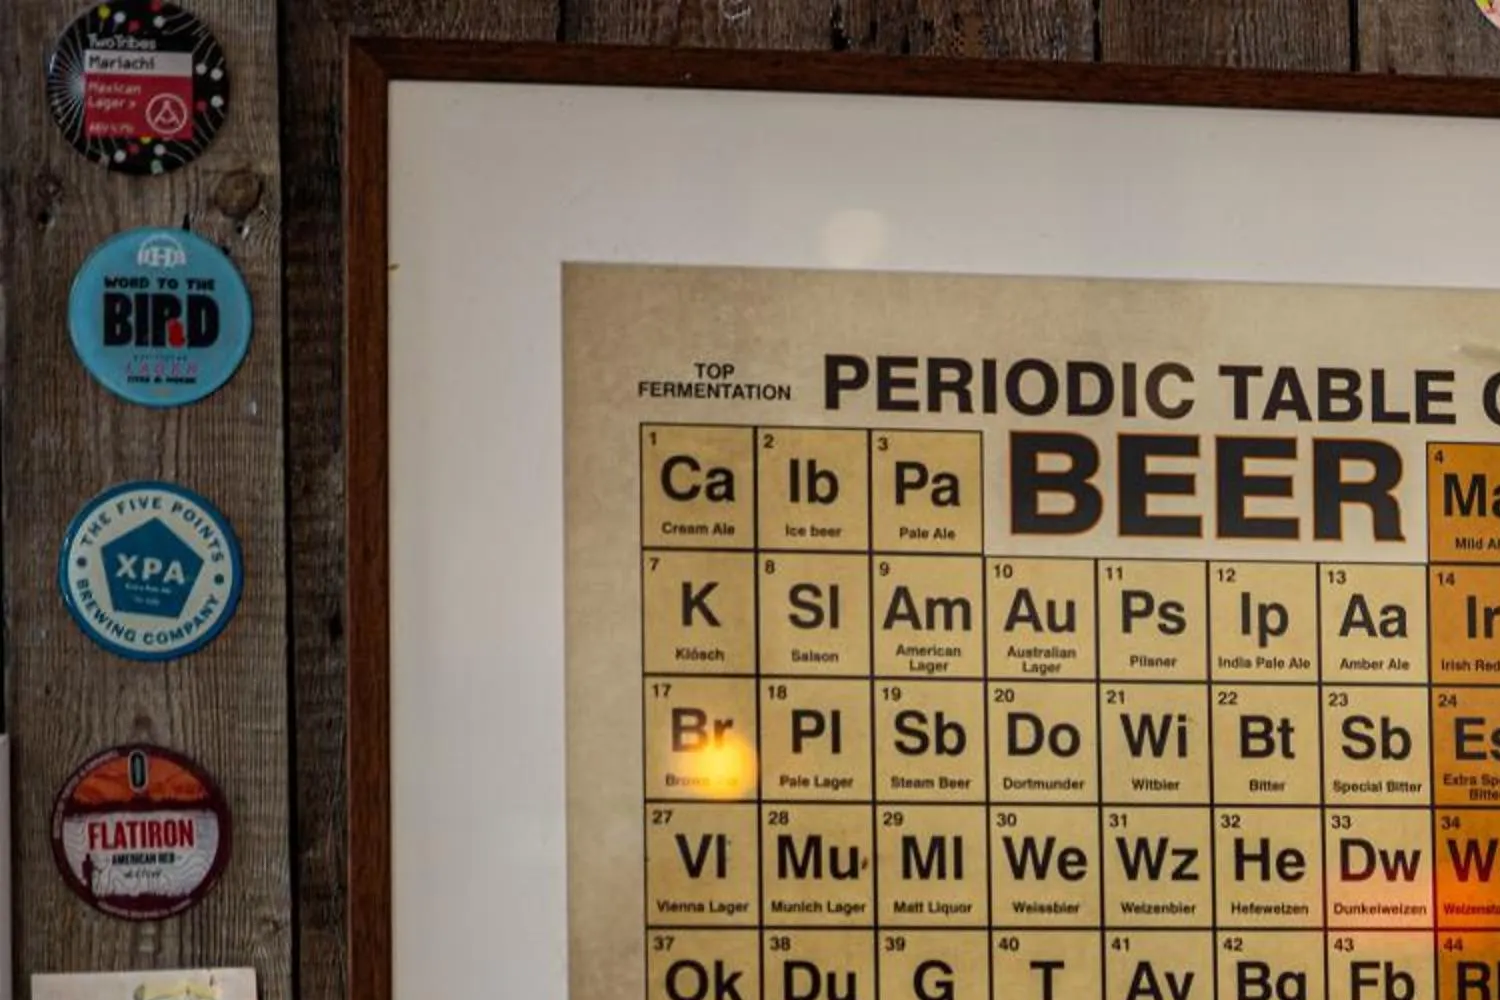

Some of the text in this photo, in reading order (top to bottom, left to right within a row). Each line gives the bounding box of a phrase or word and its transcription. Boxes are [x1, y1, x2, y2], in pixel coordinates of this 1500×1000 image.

[88, 56, 154, 70] Mariachi
[104, 276, 215, 291] WORD TO THE
[103, 293, 220, 348] BIRD
[694, 362, 735, 380] TOP
[638, 381, 792, 402] FERMENTATION
[824, 353, 1195, 419] PERIODIC
[1218, 364, 1457, 424] TABLE
[649, 432, 656, 446] 1
[877, 436, 888, 452] 3
[1434, 450, 1444, 464] 4
[660, 454, 736, 503] Ca
[894, 460, 960, 508] Pa
[1009, 430, 1406, 545] BEER
[80, 495, 224, 563] THE FIVE POINTS
[661, 521, 735, 536] Cream Ale
[899, 526, 956, 540] Pale Ale
[1455, 537, 1483, 550] Mild
[115, 553, 185, 585] XPA
[994, 564, 1013, 579] 10
[1437, 572, 1455, 586] 14
[77, 578, 219, 646] BREWING COMPANY
[882, 585, 972, 632] Am
[1003, 587, 1076, 634] Au
[1007, 645, 1077, 659] Australian
[1022, 660, 1061, 676] Lager
[1442, 659, 1471, 672] Irish
[1474, 658, 1500, 672] Red
[994, 688, 1015, 703] 20
[1007, 712, 1081, 758] Do
[1002, 776, 1085, 790] Dortmunder
[996, 812, 1017, 828] 30
[1220, 814, 1241, 829] 32
[87, 819, 195, 851] FLATIRON
[777, 833, 859, 880] Mu
[1001, 835, 1088, 882] We
[1234, 837, 1306, 883] He
[1012, 901, 1080, 915] Weissbier
[653, 936, 675, 951] 37
[998, 936, 1020, 952] 40
[1334, 937, 1354, 953] 43
